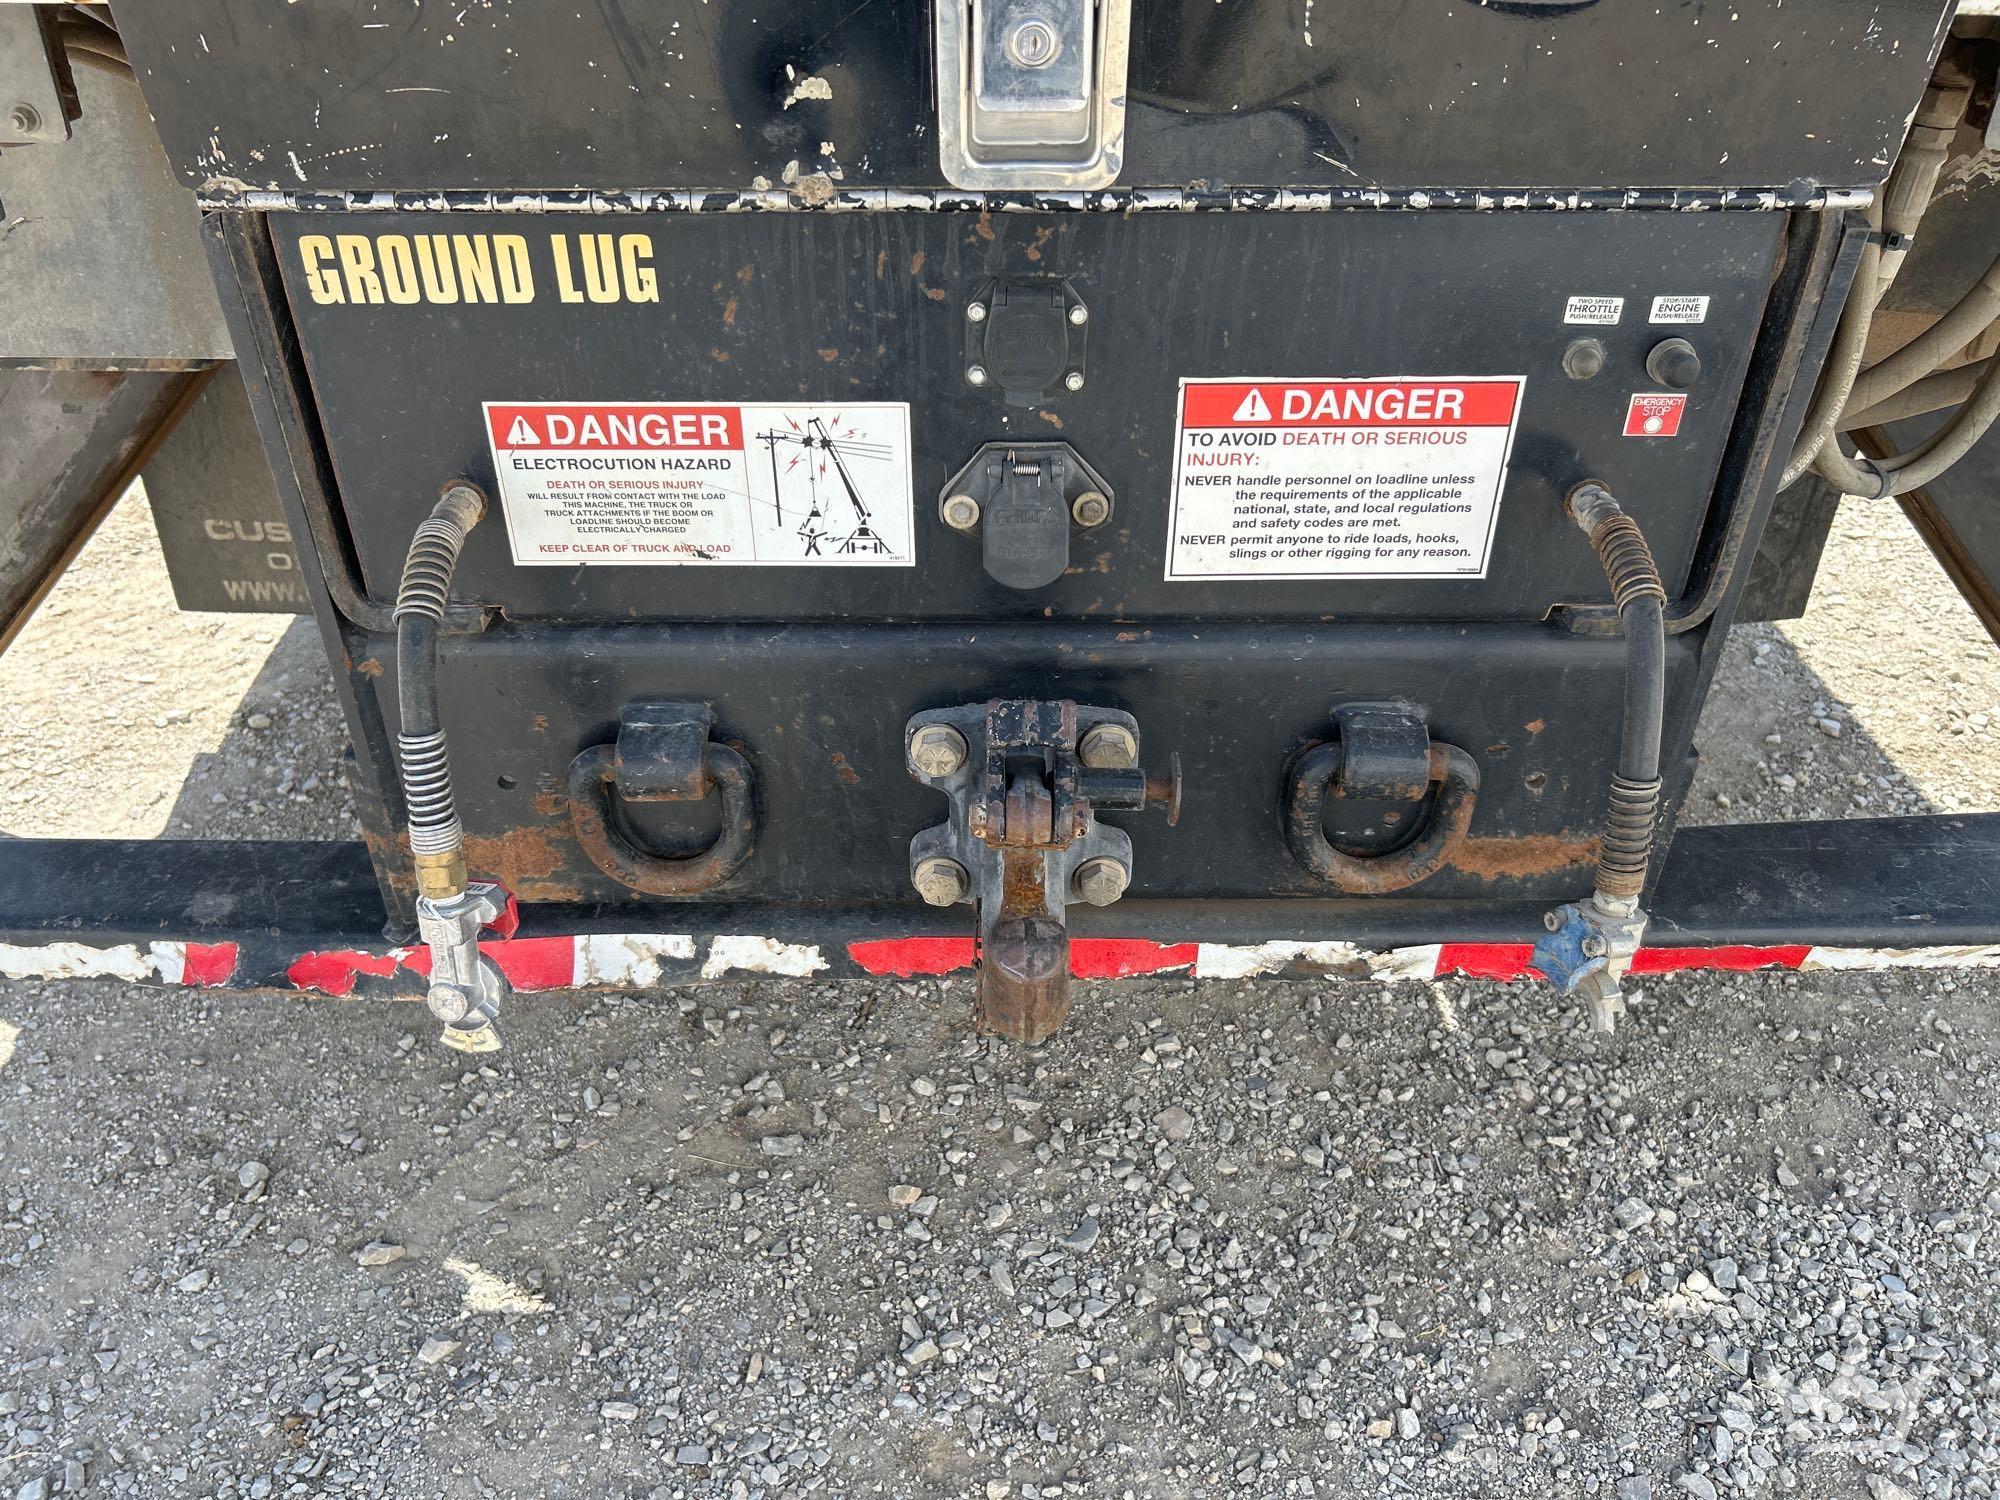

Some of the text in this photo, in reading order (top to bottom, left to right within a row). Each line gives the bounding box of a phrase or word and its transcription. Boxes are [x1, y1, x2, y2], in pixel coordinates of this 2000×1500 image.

[299, 234, 659, 304] GROUND LUG
[1569, 304, 1619, 313] THROTTLE
[1658, 304, 1700, 312] ENGINE
[1281, 389, 1464, 420] DANGER
[1635, 398, 1683, 406] EMERGENCY
[1642, 406, 1671, 415] STOP
[546, 414, 729, 446] DANGER
[1189, 432, 1468, 447] TO AVOID DEATH OR SERIOUS
[1782, 468, 1795, 482] WP
[1796, 450, 1813, 471] 3000
[1812, 433, 1826, 452] PSI
[1827, 394, 1847, 427] MSHA
[513, 459, 731, 470] ELECTROCUTION HAZARD
[1187, 454, 1260, 466] INJURY:
[547, 481, 703, 489] DEATH OR SERIOUS INJURY
[1185, 474, 1475, 489] NEVER handle personnel on loadline unless
[1235, 488, 1462, 502] the requirements of the applicable
[1234, 502, 1472, 516] national, state, and local regulations
[205, 519, 293, 542] CUS
[1232, 518, 1401, 531] and safety codes are met.
[1180, 533, 1459, 548] NEVER permit anyone to ride loads, hooks,
[1229, 547, 1471, 561] slings or other rigging for any reason.
